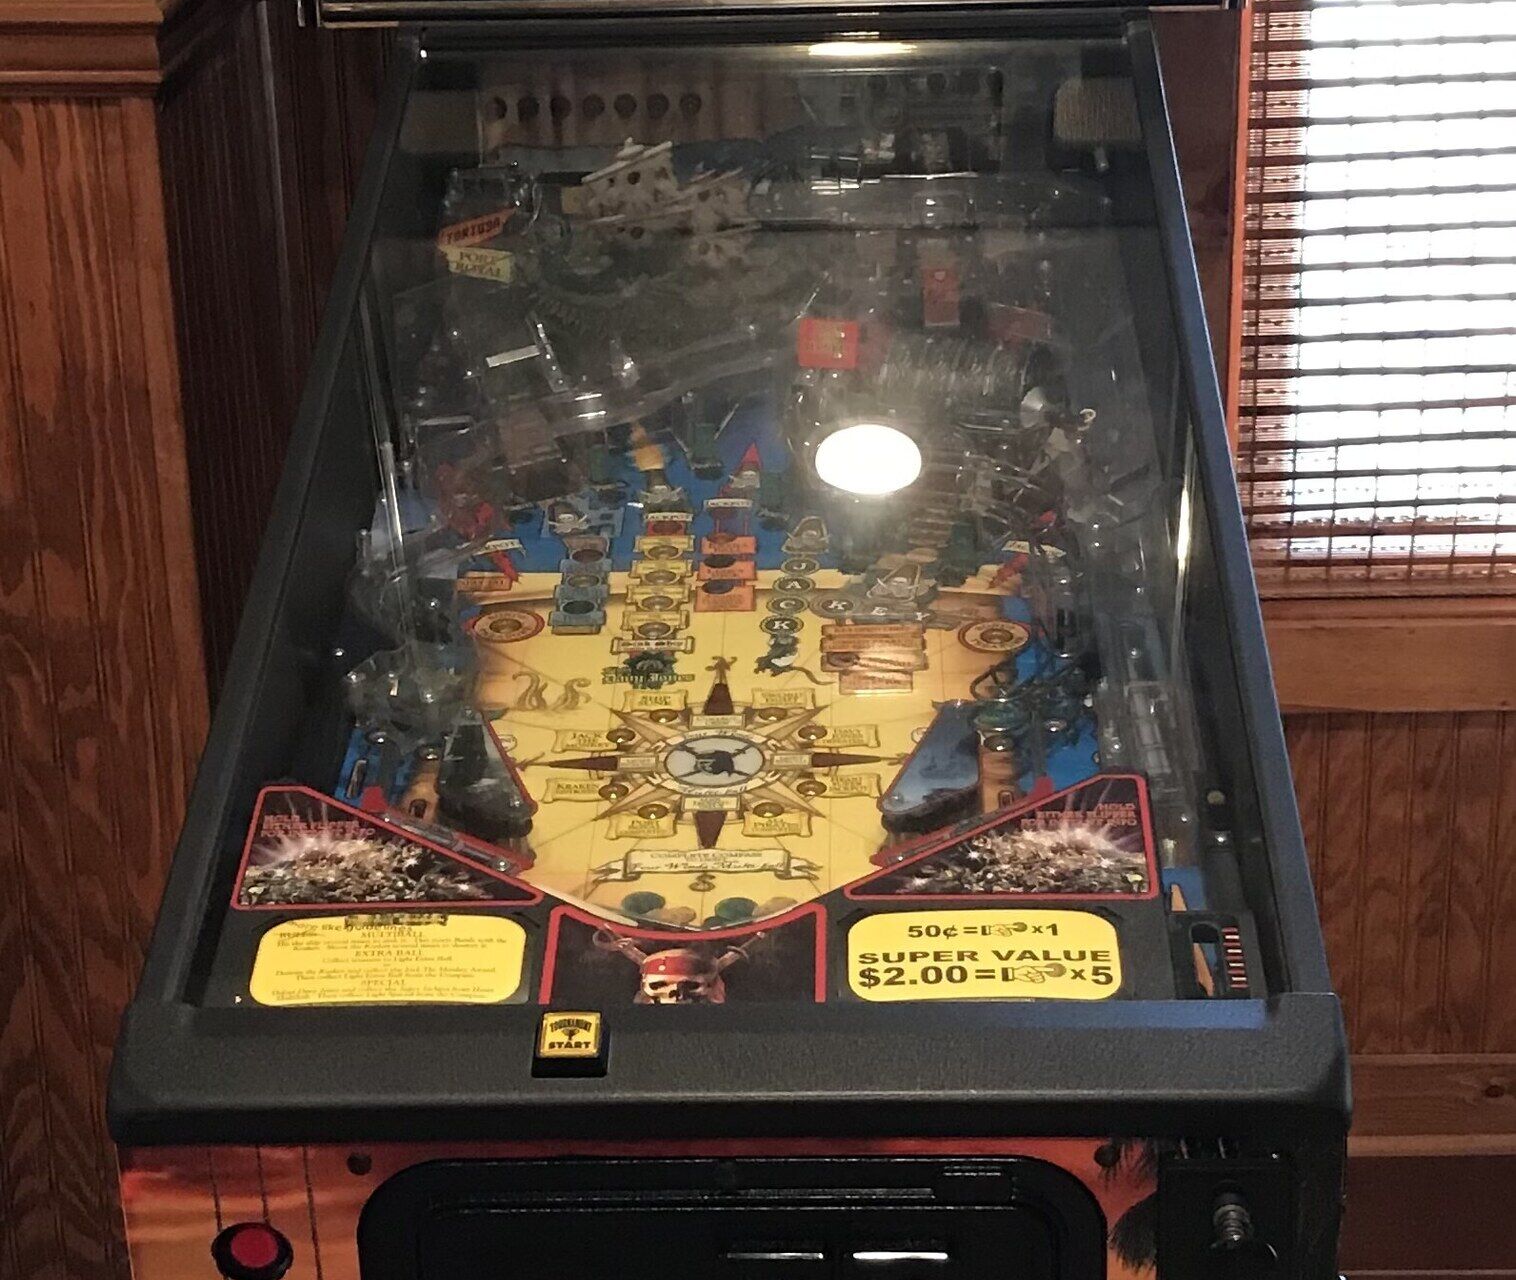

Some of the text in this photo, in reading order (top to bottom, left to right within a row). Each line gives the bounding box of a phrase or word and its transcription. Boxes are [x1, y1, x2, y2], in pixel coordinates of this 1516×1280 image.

[858, 950, 1112, 964] SUPER VALUE
[549, 1041, 591, 1049] START
